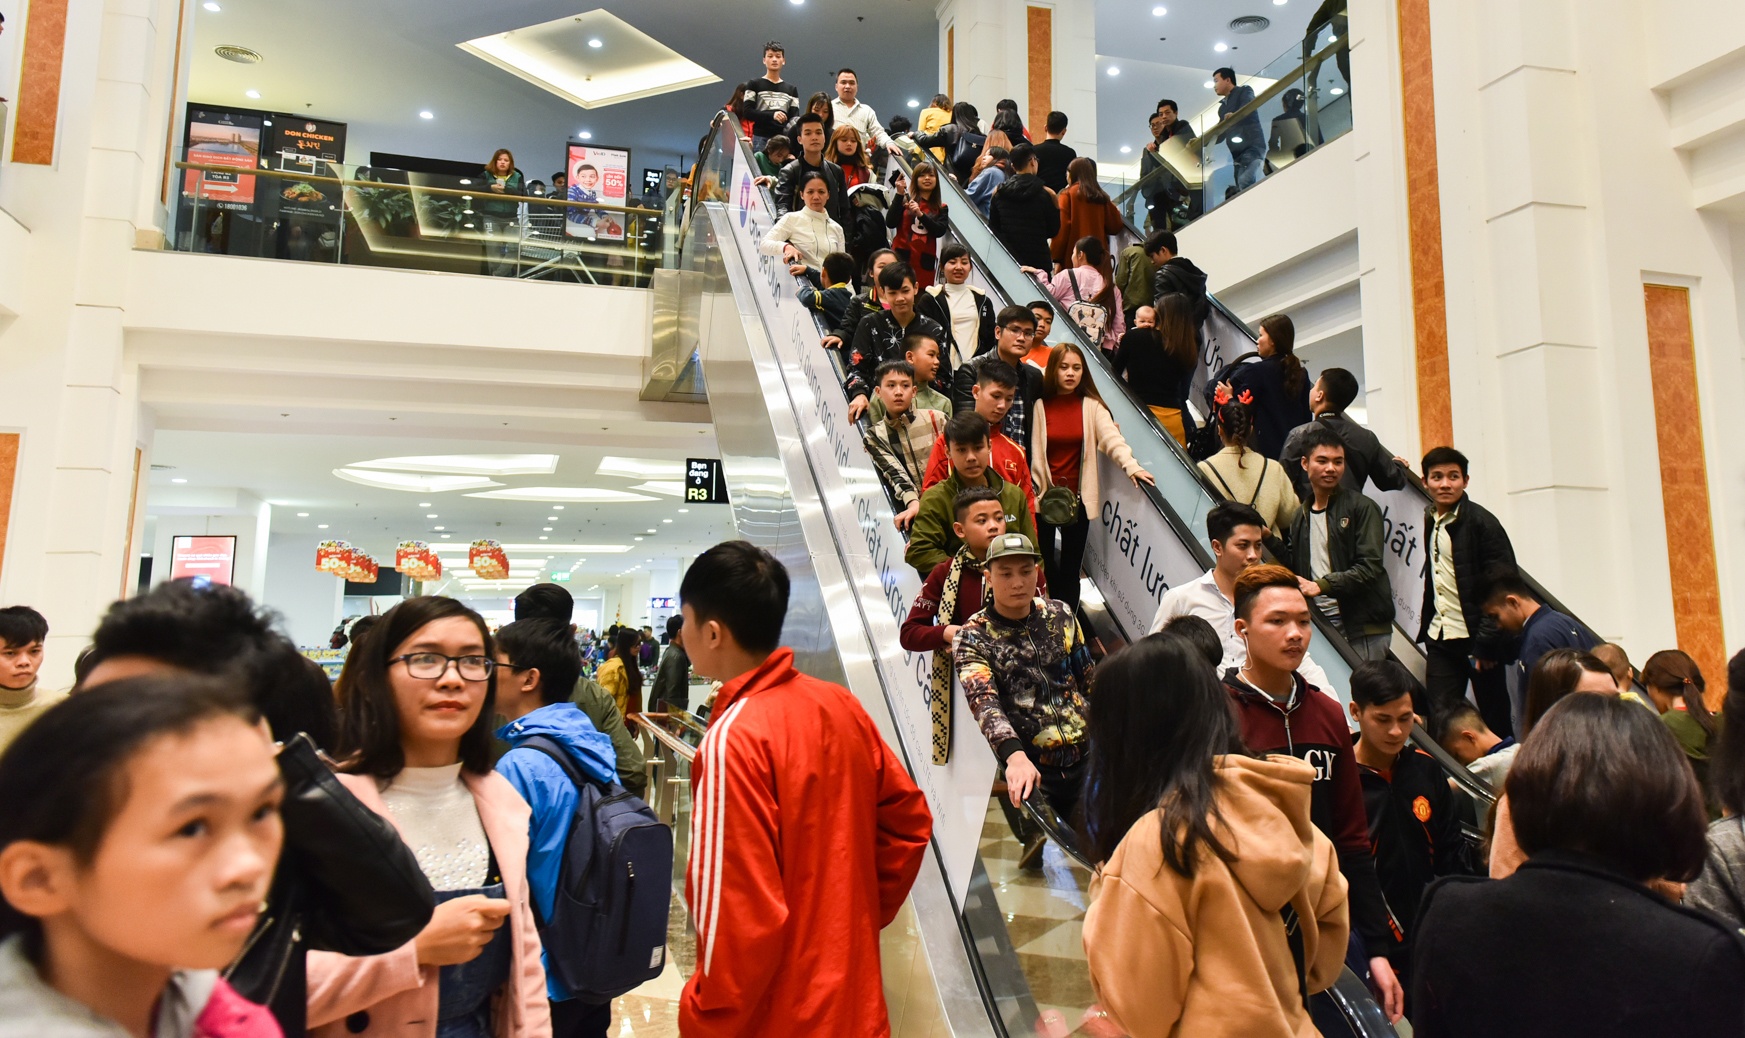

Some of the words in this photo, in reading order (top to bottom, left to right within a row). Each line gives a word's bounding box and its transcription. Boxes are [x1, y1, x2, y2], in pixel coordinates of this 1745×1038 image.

[302, 132, 334, 142] CHICKEN
[605, 179, 624, 187] 50%
[1203, 337, 1224, 373] Ứn
[691, 462, 707, 470] Bạn
[688, 487, 708, 500] R3
[1102, 500, 1140, 568] chất
[1383, 505, 1417, 567] hất
[321, 557, 348, 569] 50%
[401, 557, 426, 569] 50%
[473, 556, 498, 567] 50%
[916, 653, 932, 712] ca
